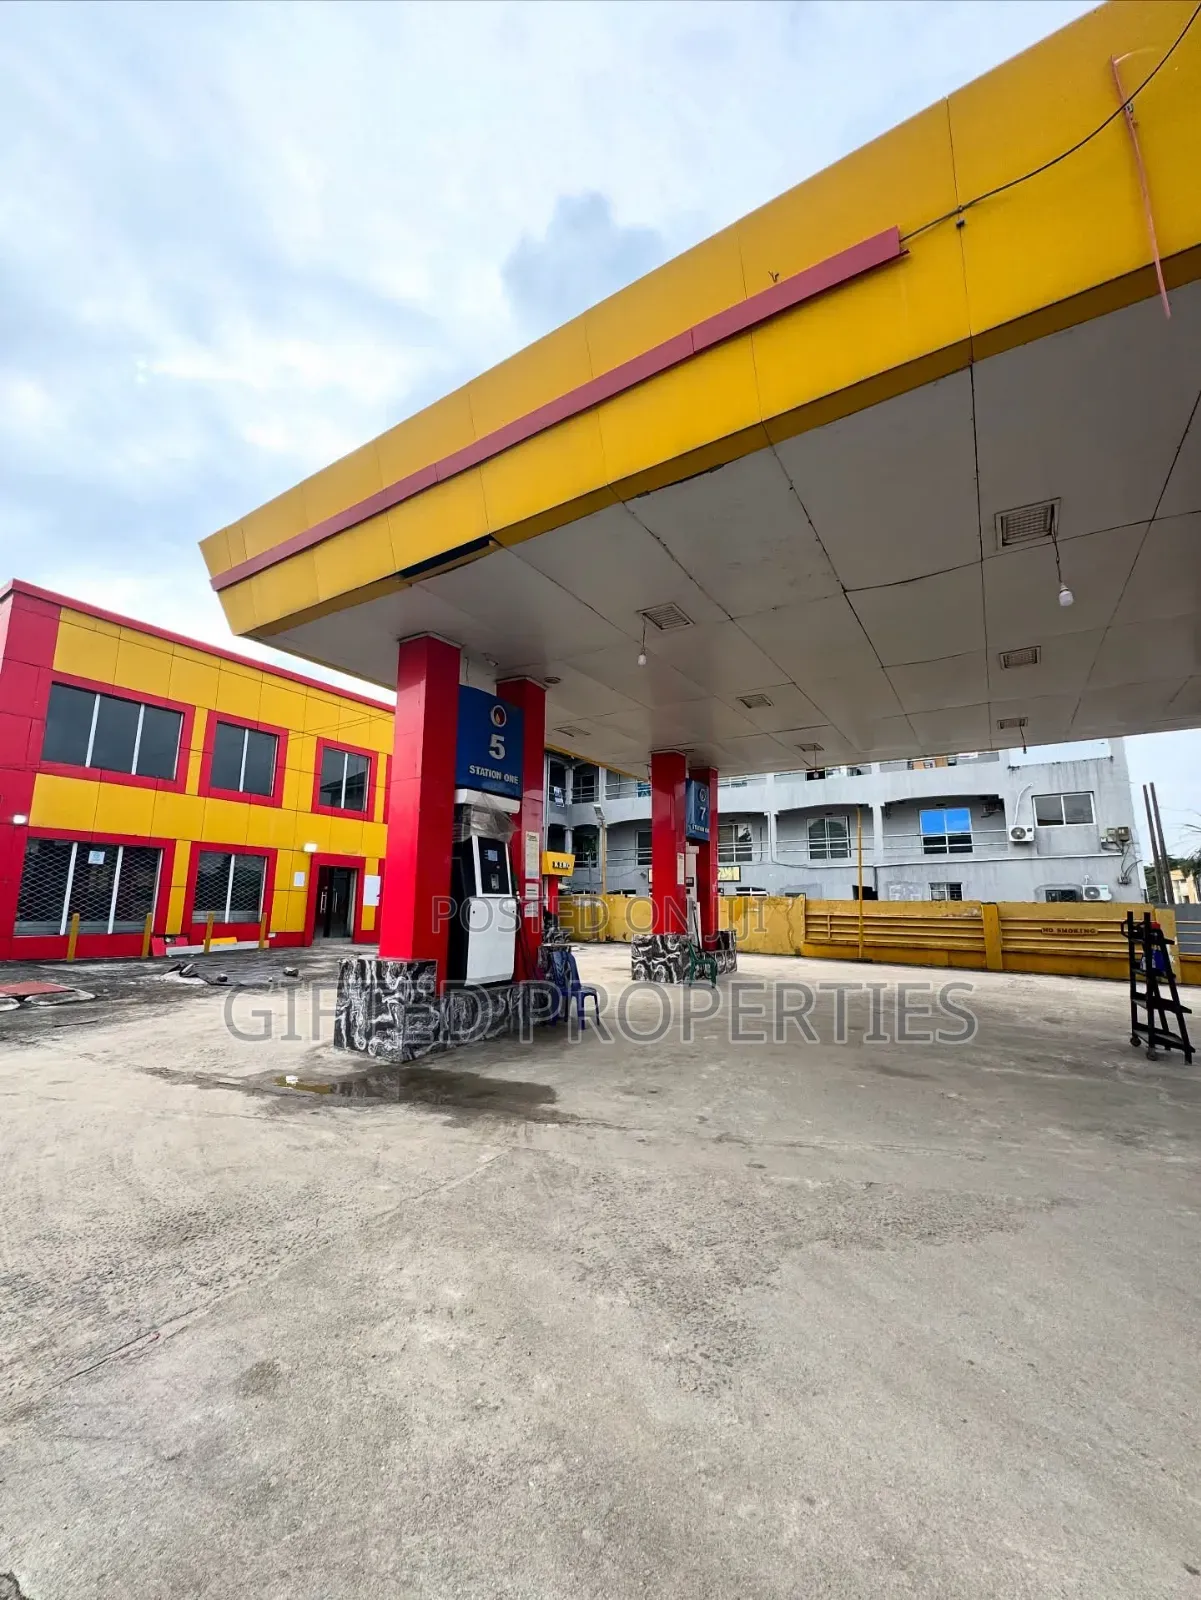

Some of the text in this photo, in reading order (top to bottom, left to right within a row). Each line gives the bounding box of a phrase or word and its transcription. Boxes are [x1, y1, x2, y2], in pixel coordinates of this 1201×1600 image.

[488, 734, 506, 760] 5
[469, 764, 519, 785] STATION ONE
[699, 806, 707, 821] 7
